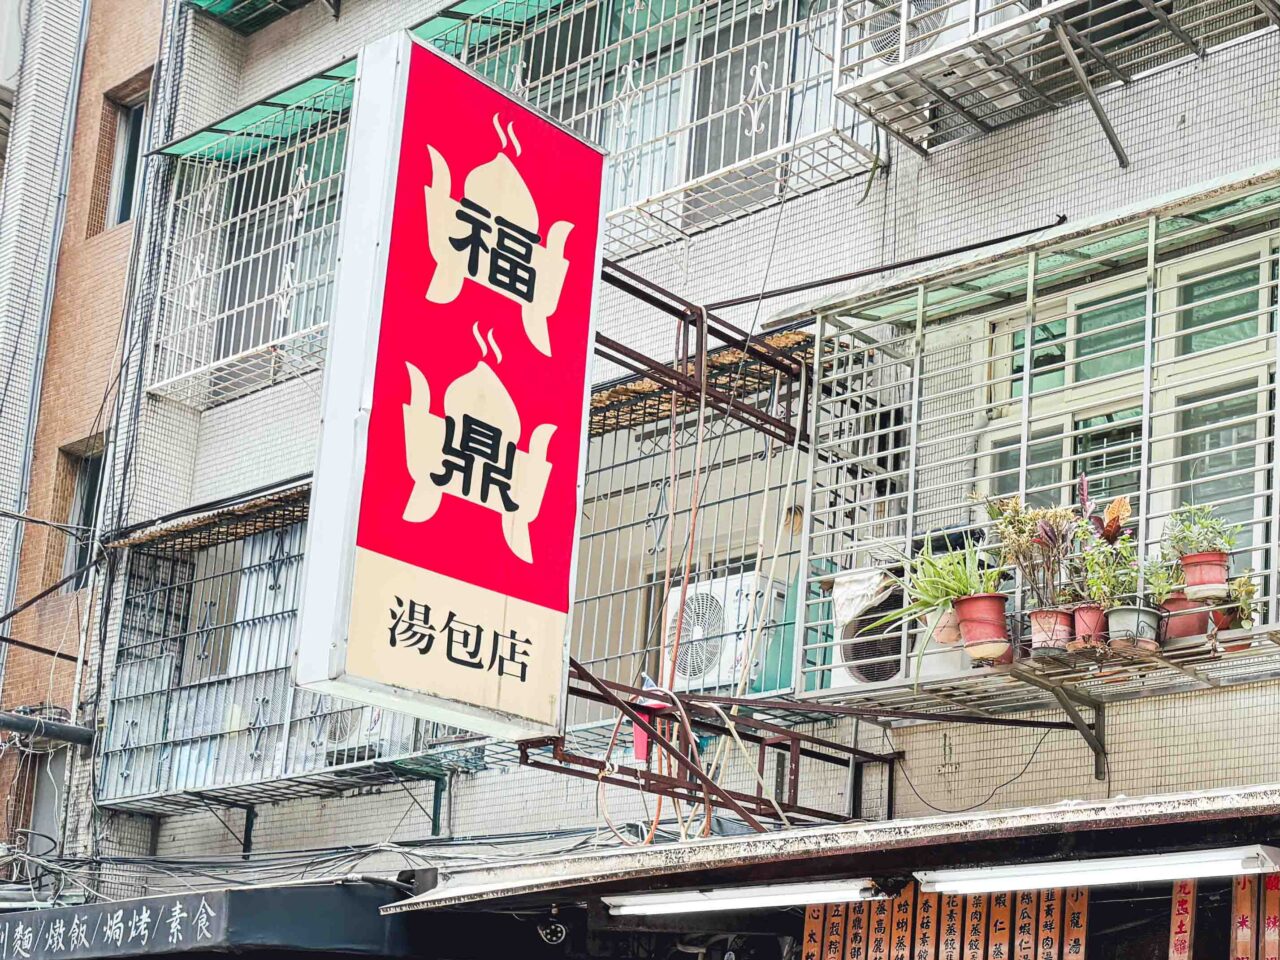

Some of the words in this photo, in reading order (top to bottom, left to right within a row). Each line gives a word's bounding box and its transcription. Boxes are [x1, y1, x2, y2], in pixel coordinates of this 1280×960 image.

[430, 198, 541, 511] 福鼎
[389, 594, 533, 682] 湯包店
